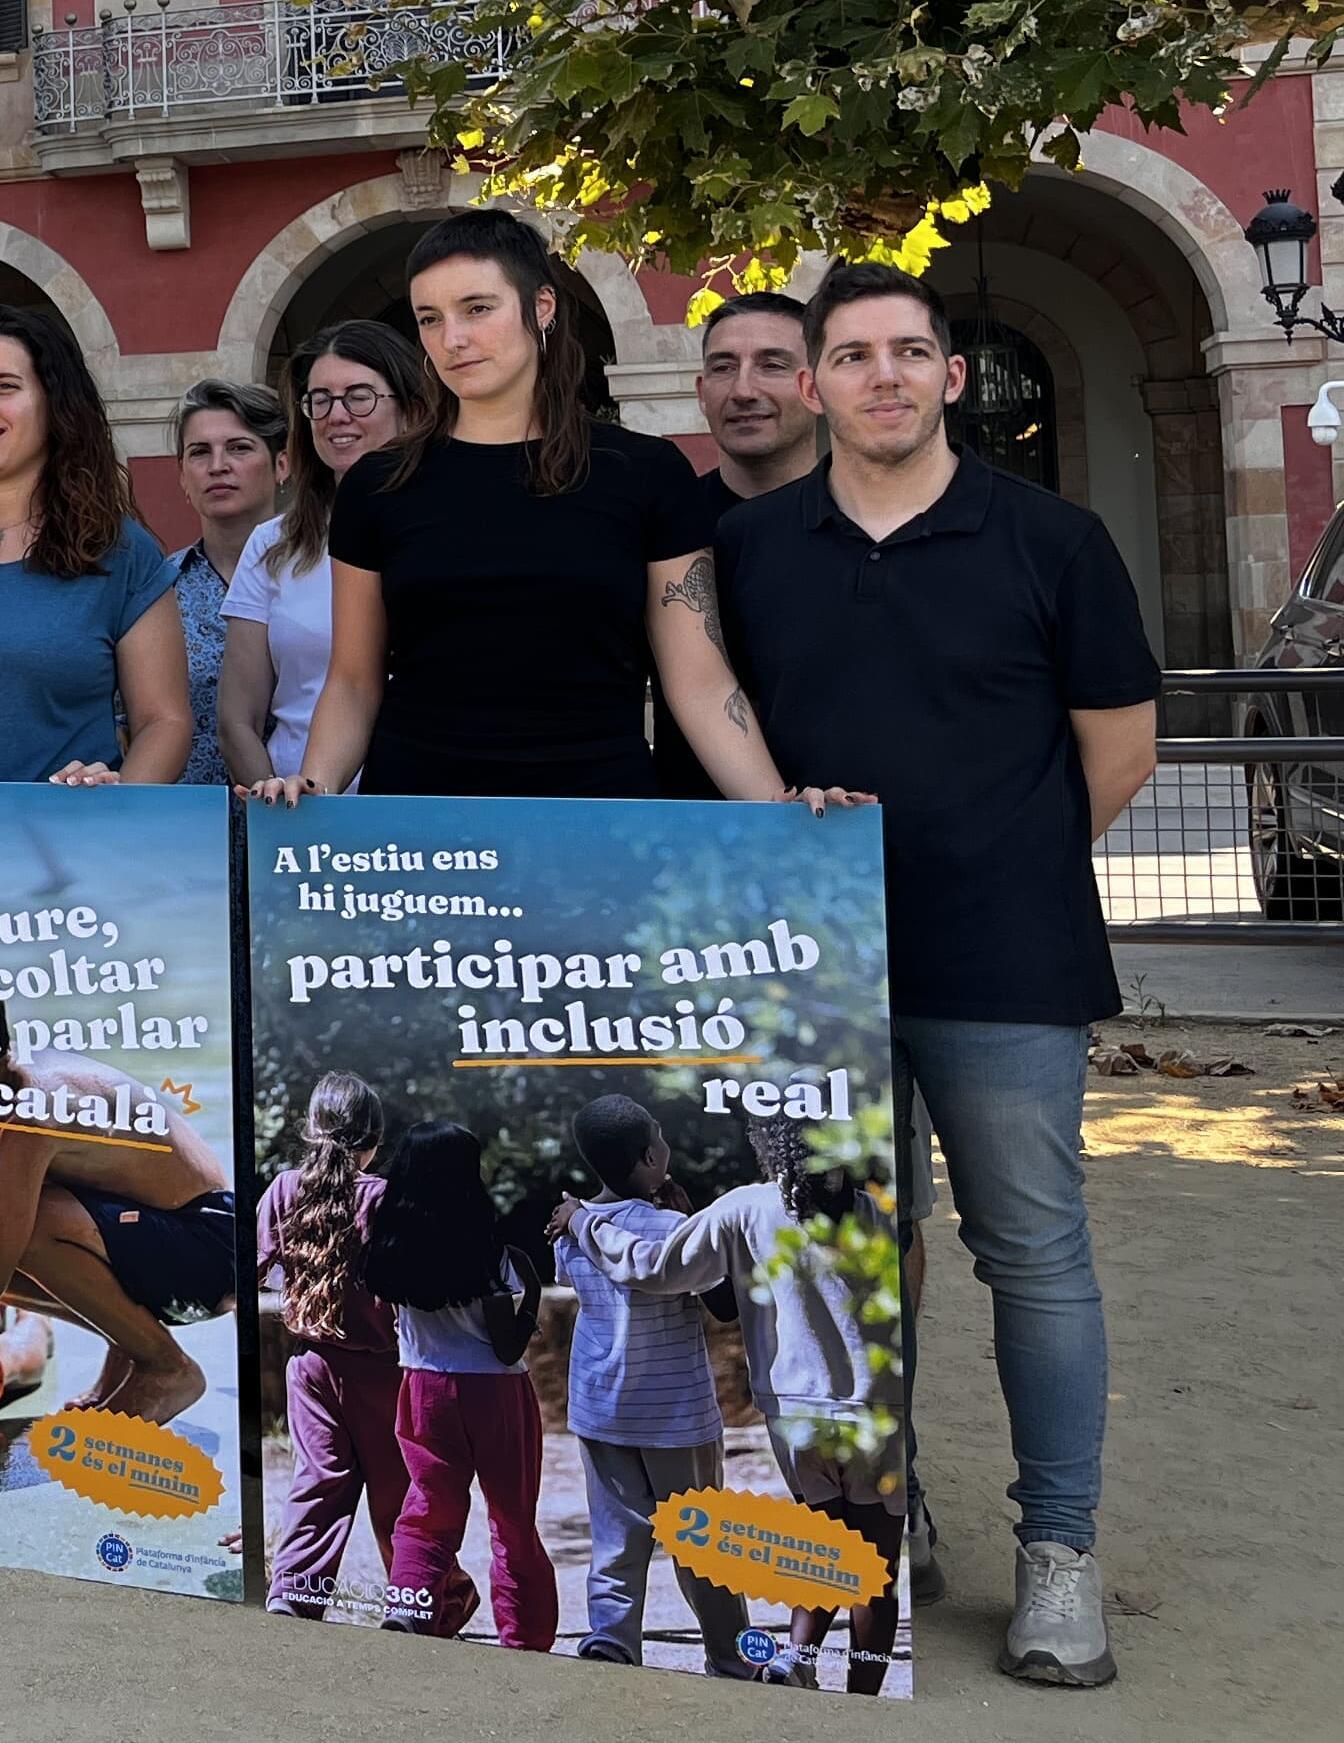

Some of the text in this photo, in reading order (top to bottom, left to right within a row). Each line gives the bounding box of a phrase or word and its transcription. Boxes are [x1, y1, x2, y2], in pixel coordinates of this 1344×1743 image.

[274, 844, 499, 874] A l'estiu ens
[298, 883, 523, 922] hi juguem...
[287, 919, 820, 1003] participar amb
[11, 1002, 208, 1065] parlar
[457, 998, 745, 1054] inclusió
[702, 1069, 853, 1122] real
[48, 1426, 184, 1473] 2 setmanes
[82, 1452, 104, 1471] és
[108, 1461, 126, 1477] el
[676, 1506, 841, 1560] 2 setmanes
[717, 1536, 743, 1557] és
[748, 1546, 770, 1565] el
